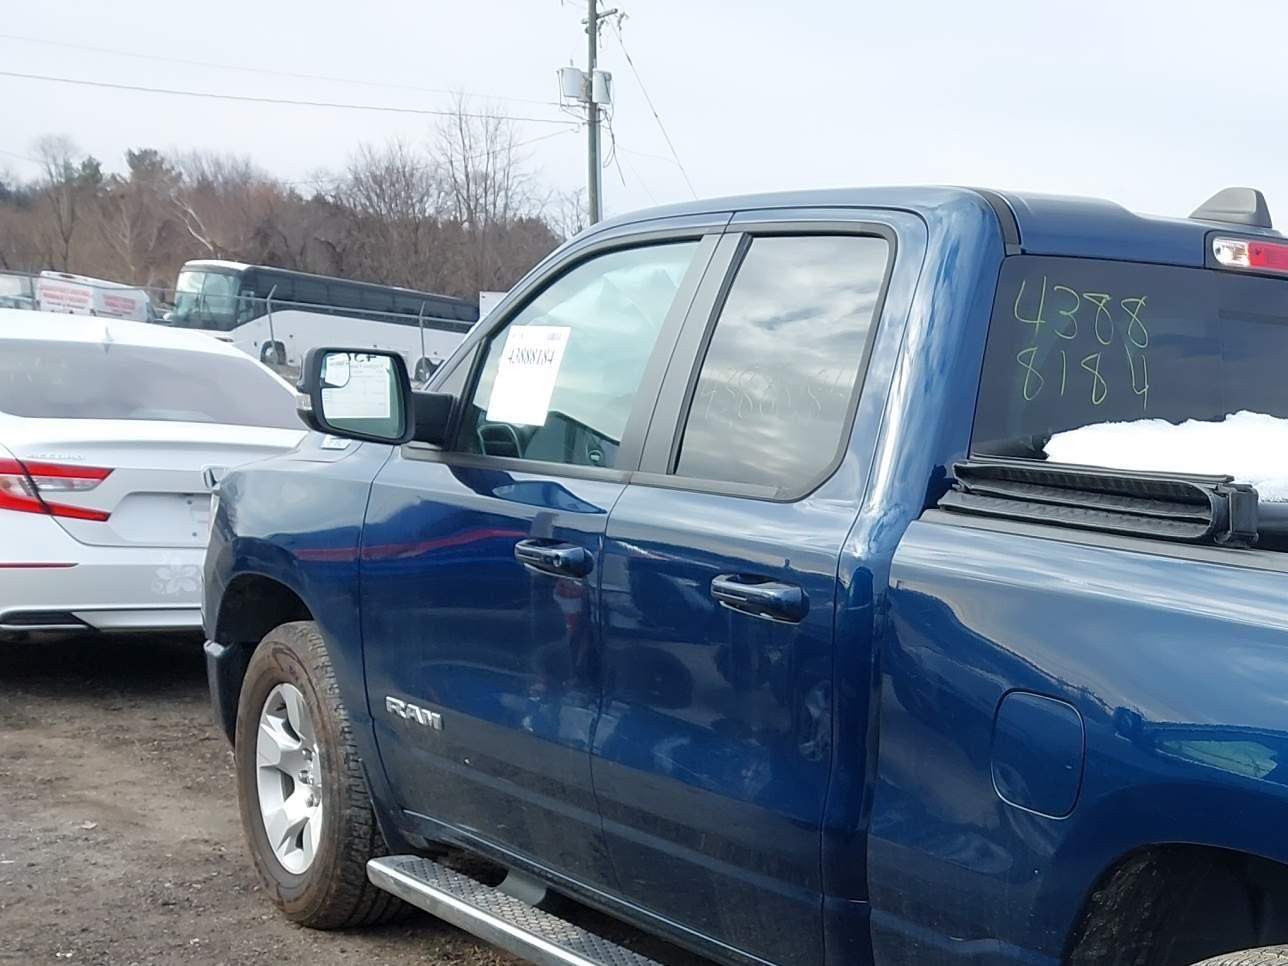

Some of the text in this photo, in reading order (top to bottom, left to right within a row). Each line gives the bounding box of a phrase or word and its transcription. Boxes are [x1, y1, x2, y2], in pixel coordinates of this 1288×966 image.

[1013, 274, 1150, 349] 4388
[1016, 343, 1150, 410] 8184
[385, 695, 442, 731] RAM
